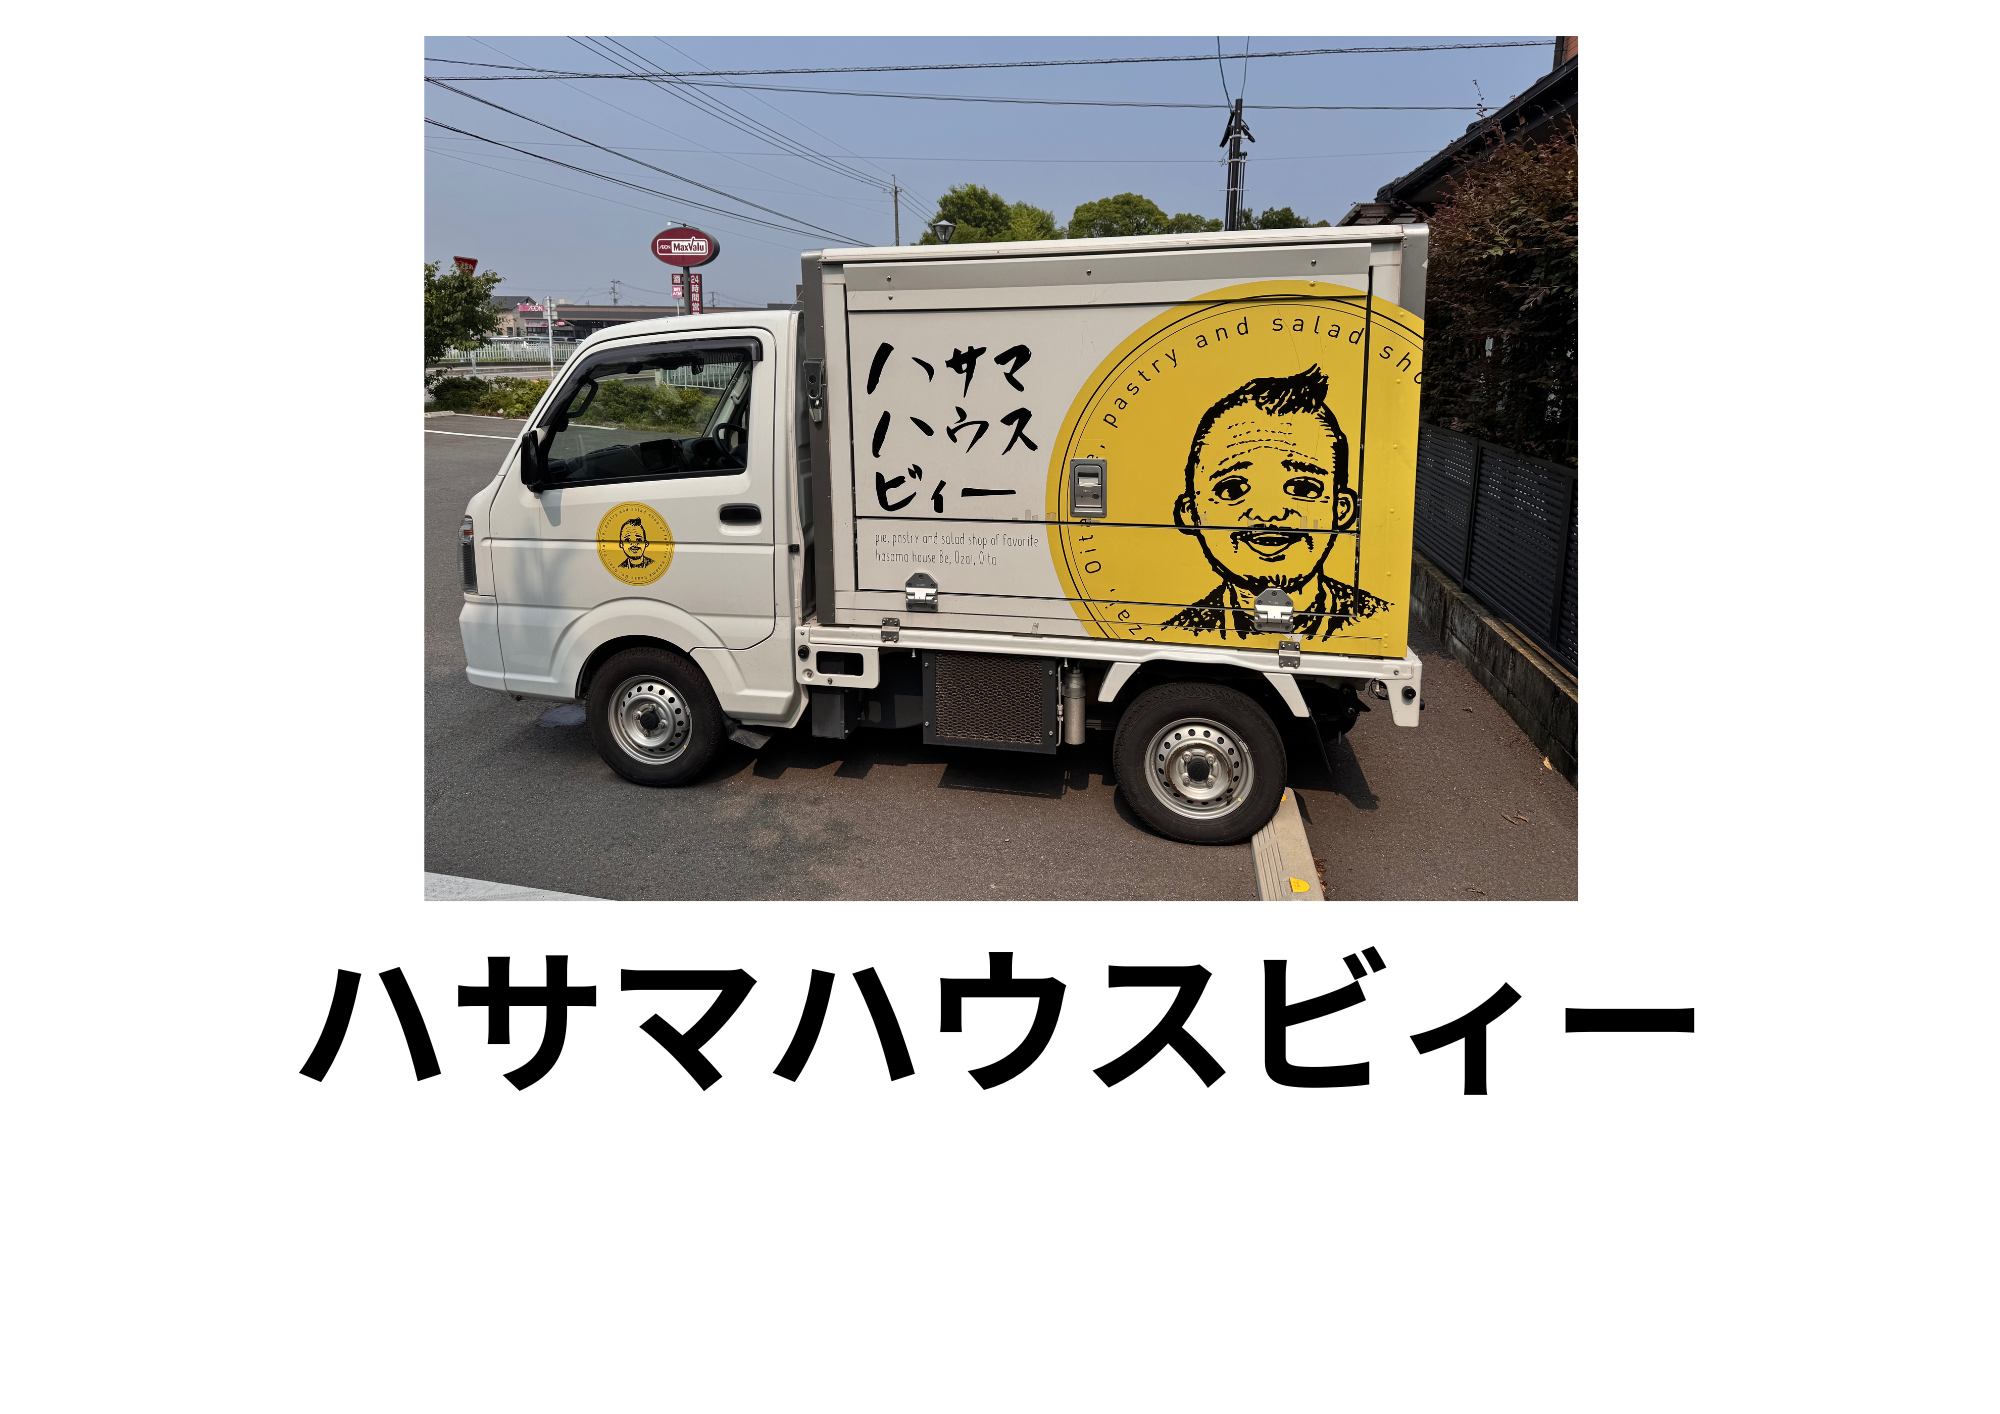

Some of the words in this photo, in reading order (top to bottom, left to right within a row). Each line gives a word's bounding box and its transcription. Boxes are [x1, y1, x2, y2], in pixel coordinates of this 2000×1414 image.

[673, 238, 705, 252] MaxValu
[867, 342, 1032, 399] ハサマ
[1103, 349, 1177, 429] pastry
[1195, 316, 1249, 348] and
[1272, 315, 1365, 345] salad
[872, 406, 1039, 459] ハウス
[875, 463, 1017, 514] ビィー
[875, 533, 890, 546] pie,
[892, 531, 919, 547] pastry
[922, 531, 938, 545] and
[941, 532, 965, 545] salad
[968, 532, 988, 549] shop
[990, 533, 1000, 546] of
[1003, 533, 1039, 548] favorite
[875, 549, 909, 563] hasama
[911, 550, 936, 563] house
[939, 549, 952, 565] Be,
[954, 549, 976, 566] Ozai,
